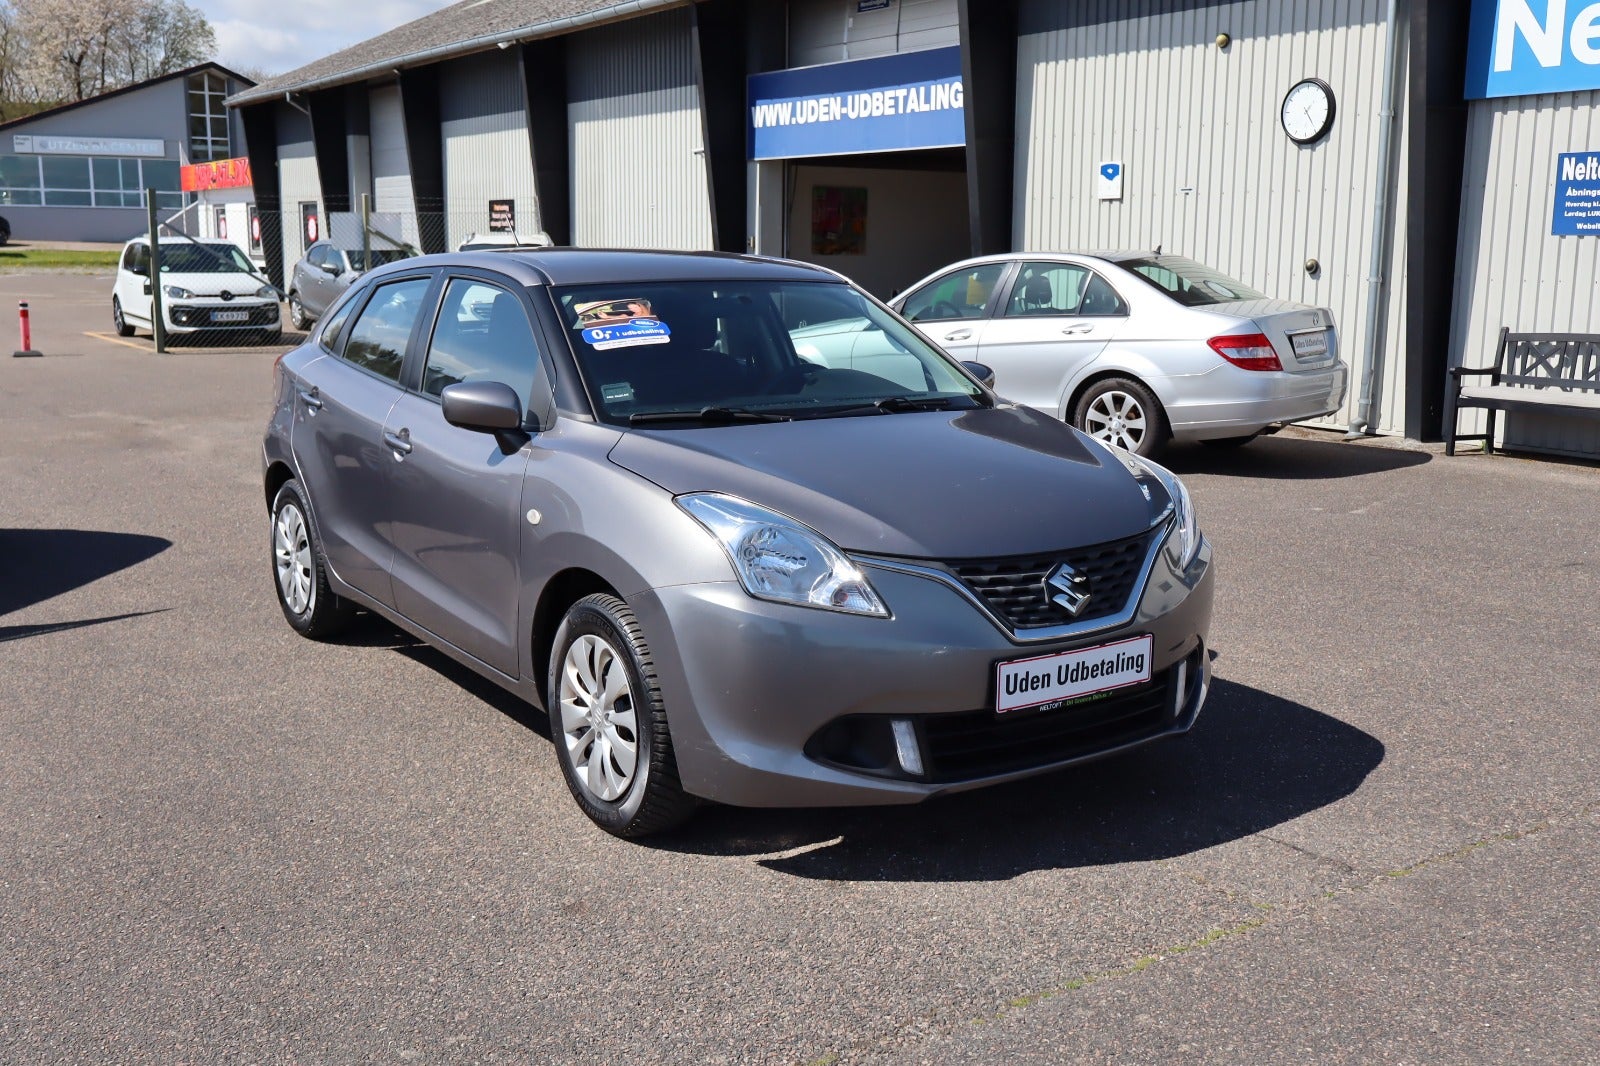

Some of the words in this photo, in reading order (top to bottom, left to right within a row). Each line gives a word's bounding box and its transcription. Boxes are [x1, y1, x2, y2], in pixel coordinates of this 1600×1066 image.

[752, 81, 963, 128] WWW.UDEN-UDBETALING
[1562, 156, 1600, 180] Nelt
[1005, 671, 1050, 695] Uden
[1057, 652, 1144, 685] Udbetaling
[1039, 701, 1063, 711] NELTOFT
